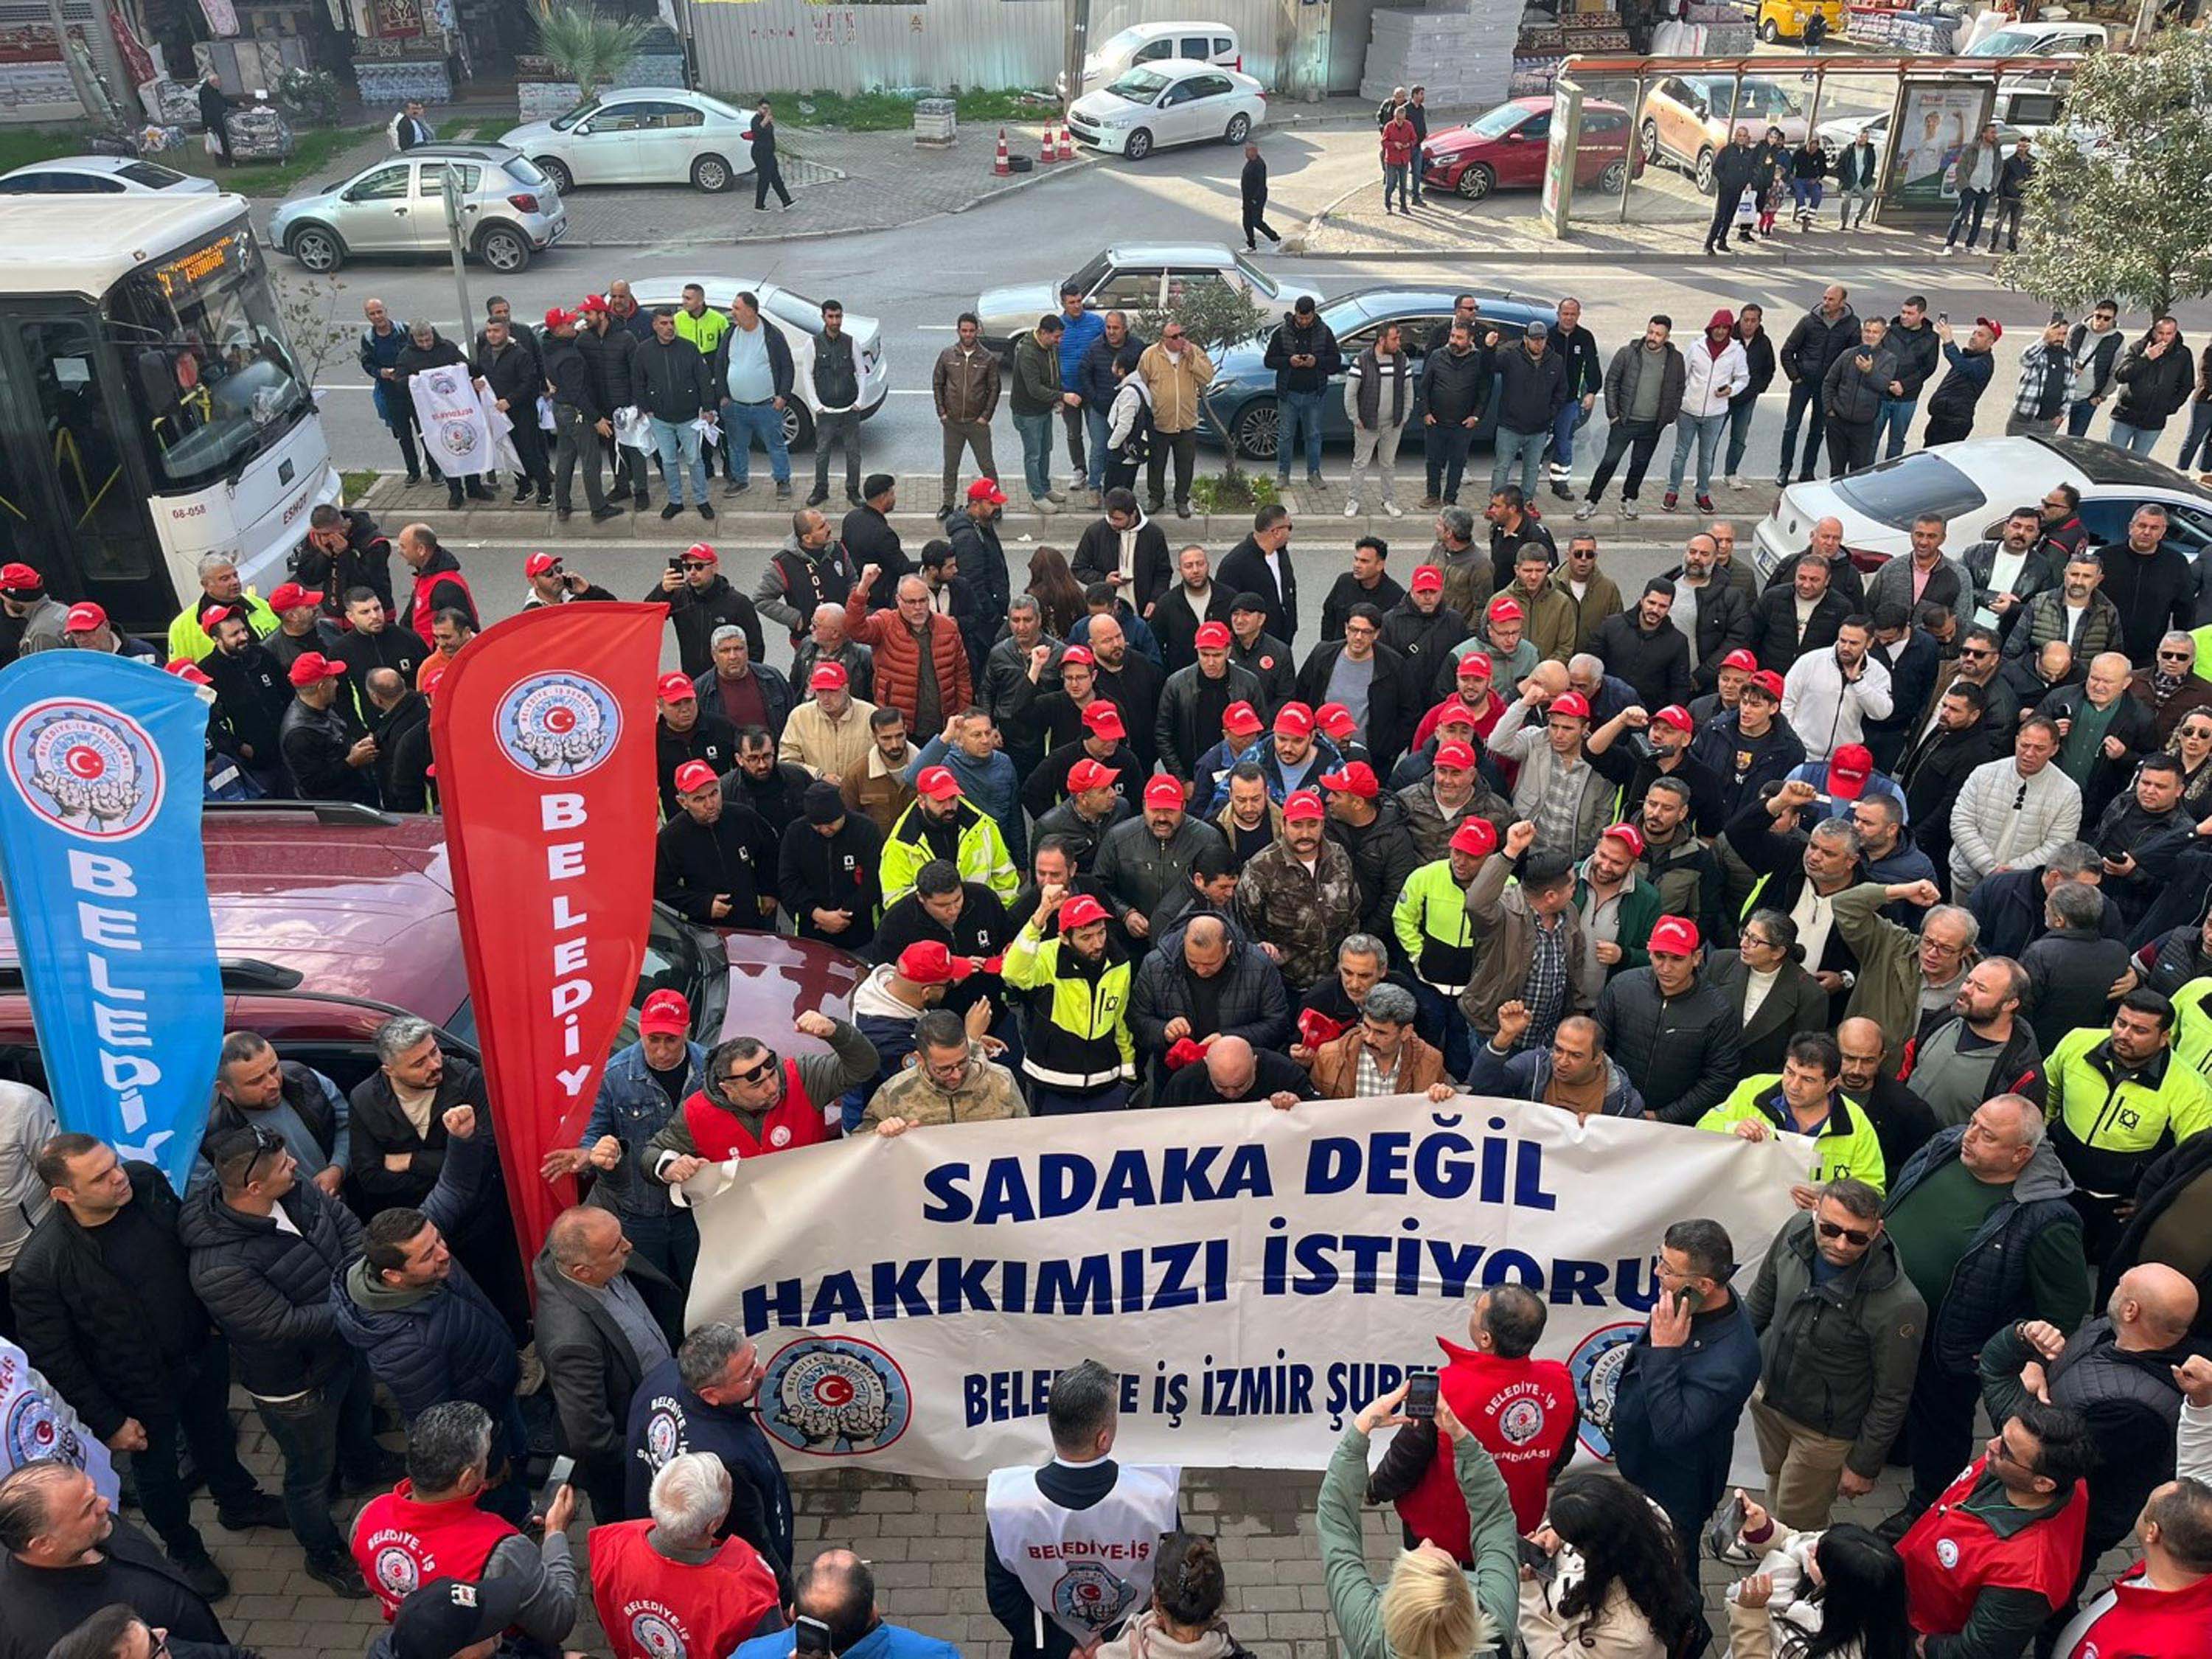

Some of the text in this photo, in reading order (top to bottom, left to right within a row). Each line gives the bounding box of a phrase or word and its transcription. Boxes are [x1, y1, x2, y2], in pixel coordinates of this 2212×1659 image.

[282, 493, 307, 524] ESHOT
[540, 793, 593, 1125] BELEDİY
[67, 849, 175, 1180] BELEDİY
[923, 1113, 1557, 1225] SADAKA DEĞİL
[742, 1217, 1742, 1337] HAKKIMIZI İSTİYORU
[964, 1359, 1140, 1428] BELEE
[1152, 1360, 1189, 1429] İŞ
[1201, 1348, 1314, 1416] İZMİR
[1494, 1449, 1551, 1463] ENDİKASI
[1027, 1540, 1150, 1561] BELEDİYE-İŞ
